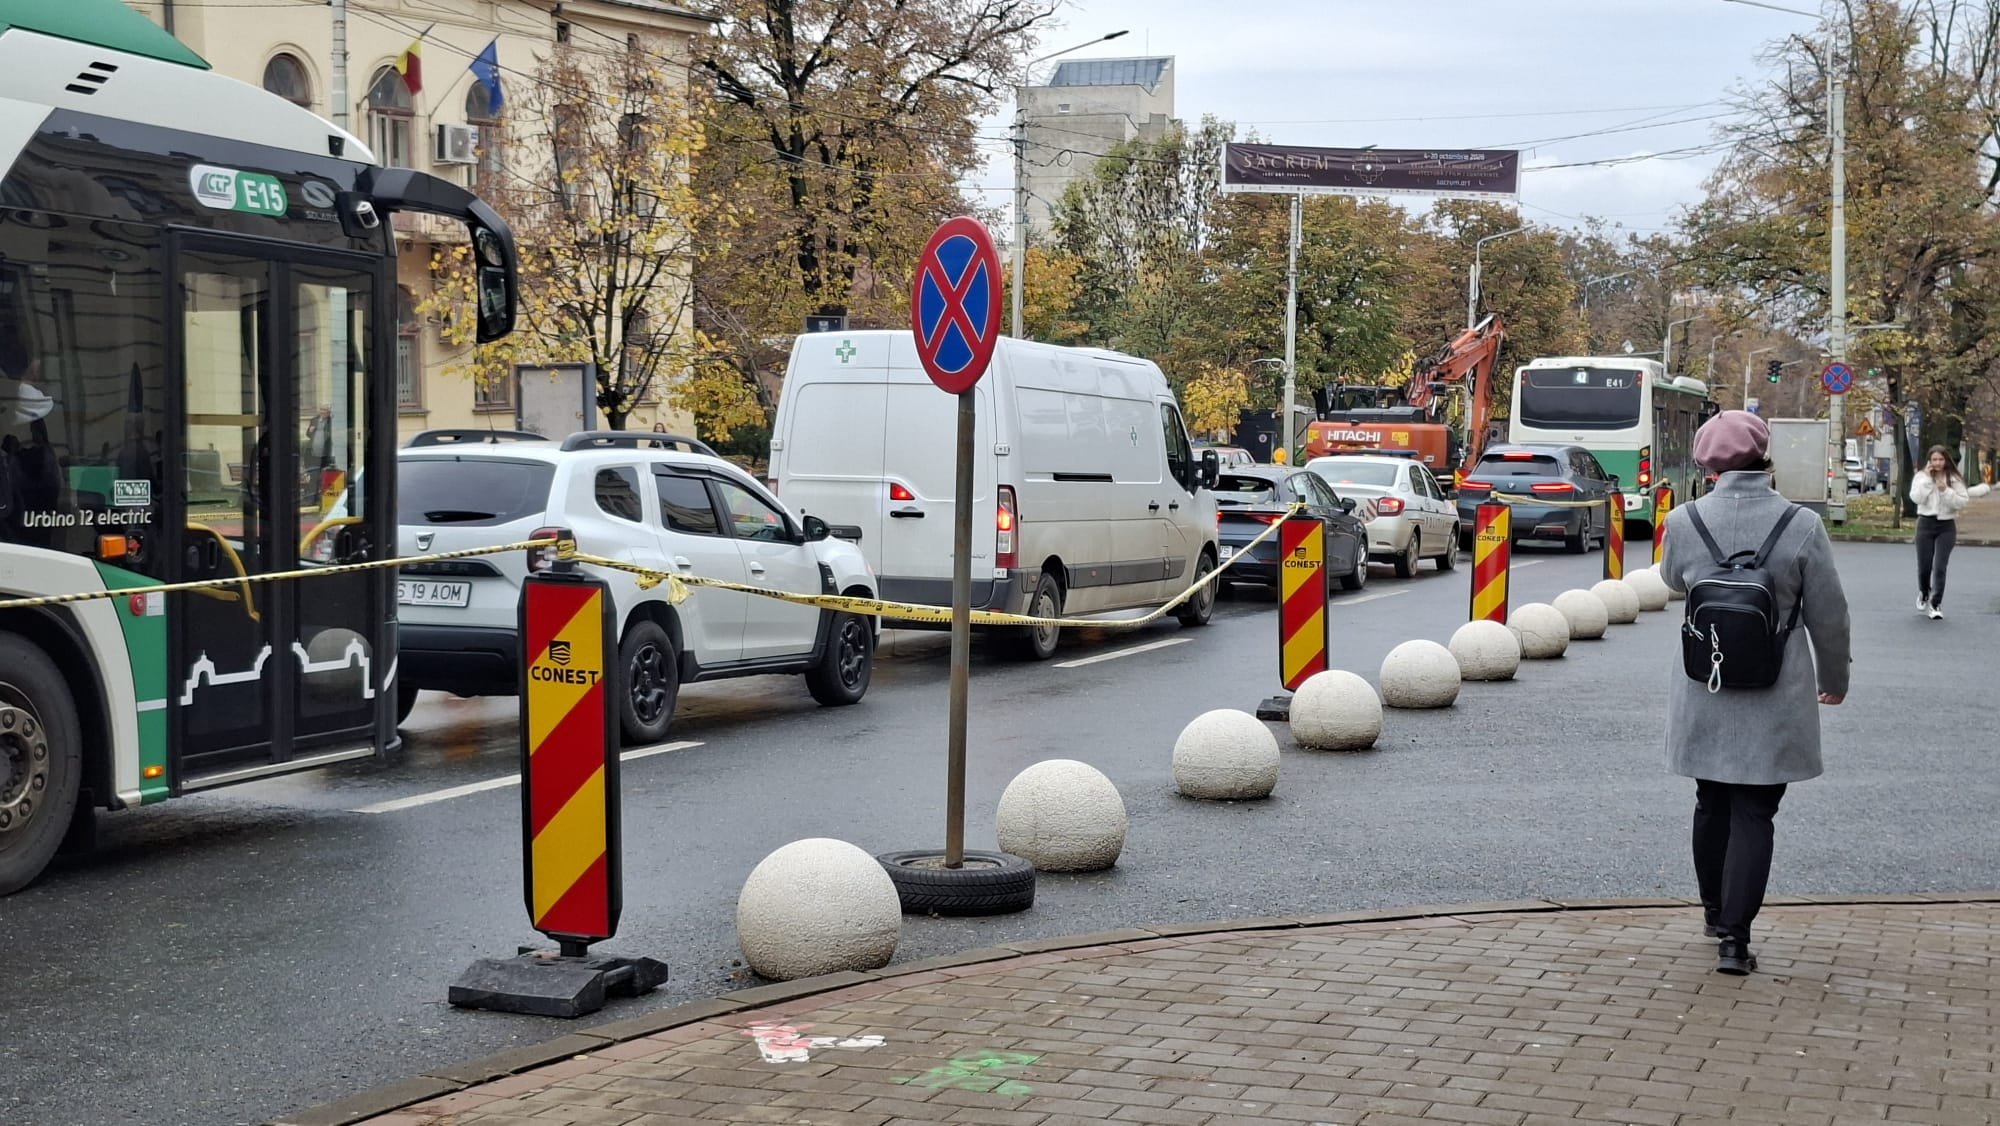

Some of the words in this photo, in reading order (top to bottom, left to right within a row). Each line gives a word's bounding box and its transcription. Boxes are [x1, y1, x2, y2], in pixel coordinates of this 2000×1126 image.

[1243, 155, 1329, 170] SACRUM
[242, 179, 283, 212] E15
[1606, 378, 1623, 388] E41
[1327, 430, 1381, 442] HITACHI
[23, 510, 76, 528] Urbino
[79, 509, 94, 526] 12
[97, 508, 152, 525] electric
[1284, 560, 1321, 568] CONEST
[412, 583, 426, 599] 19
[430, 584, 462, 601] AOM
[530, 666, 599, 686] CONEST
